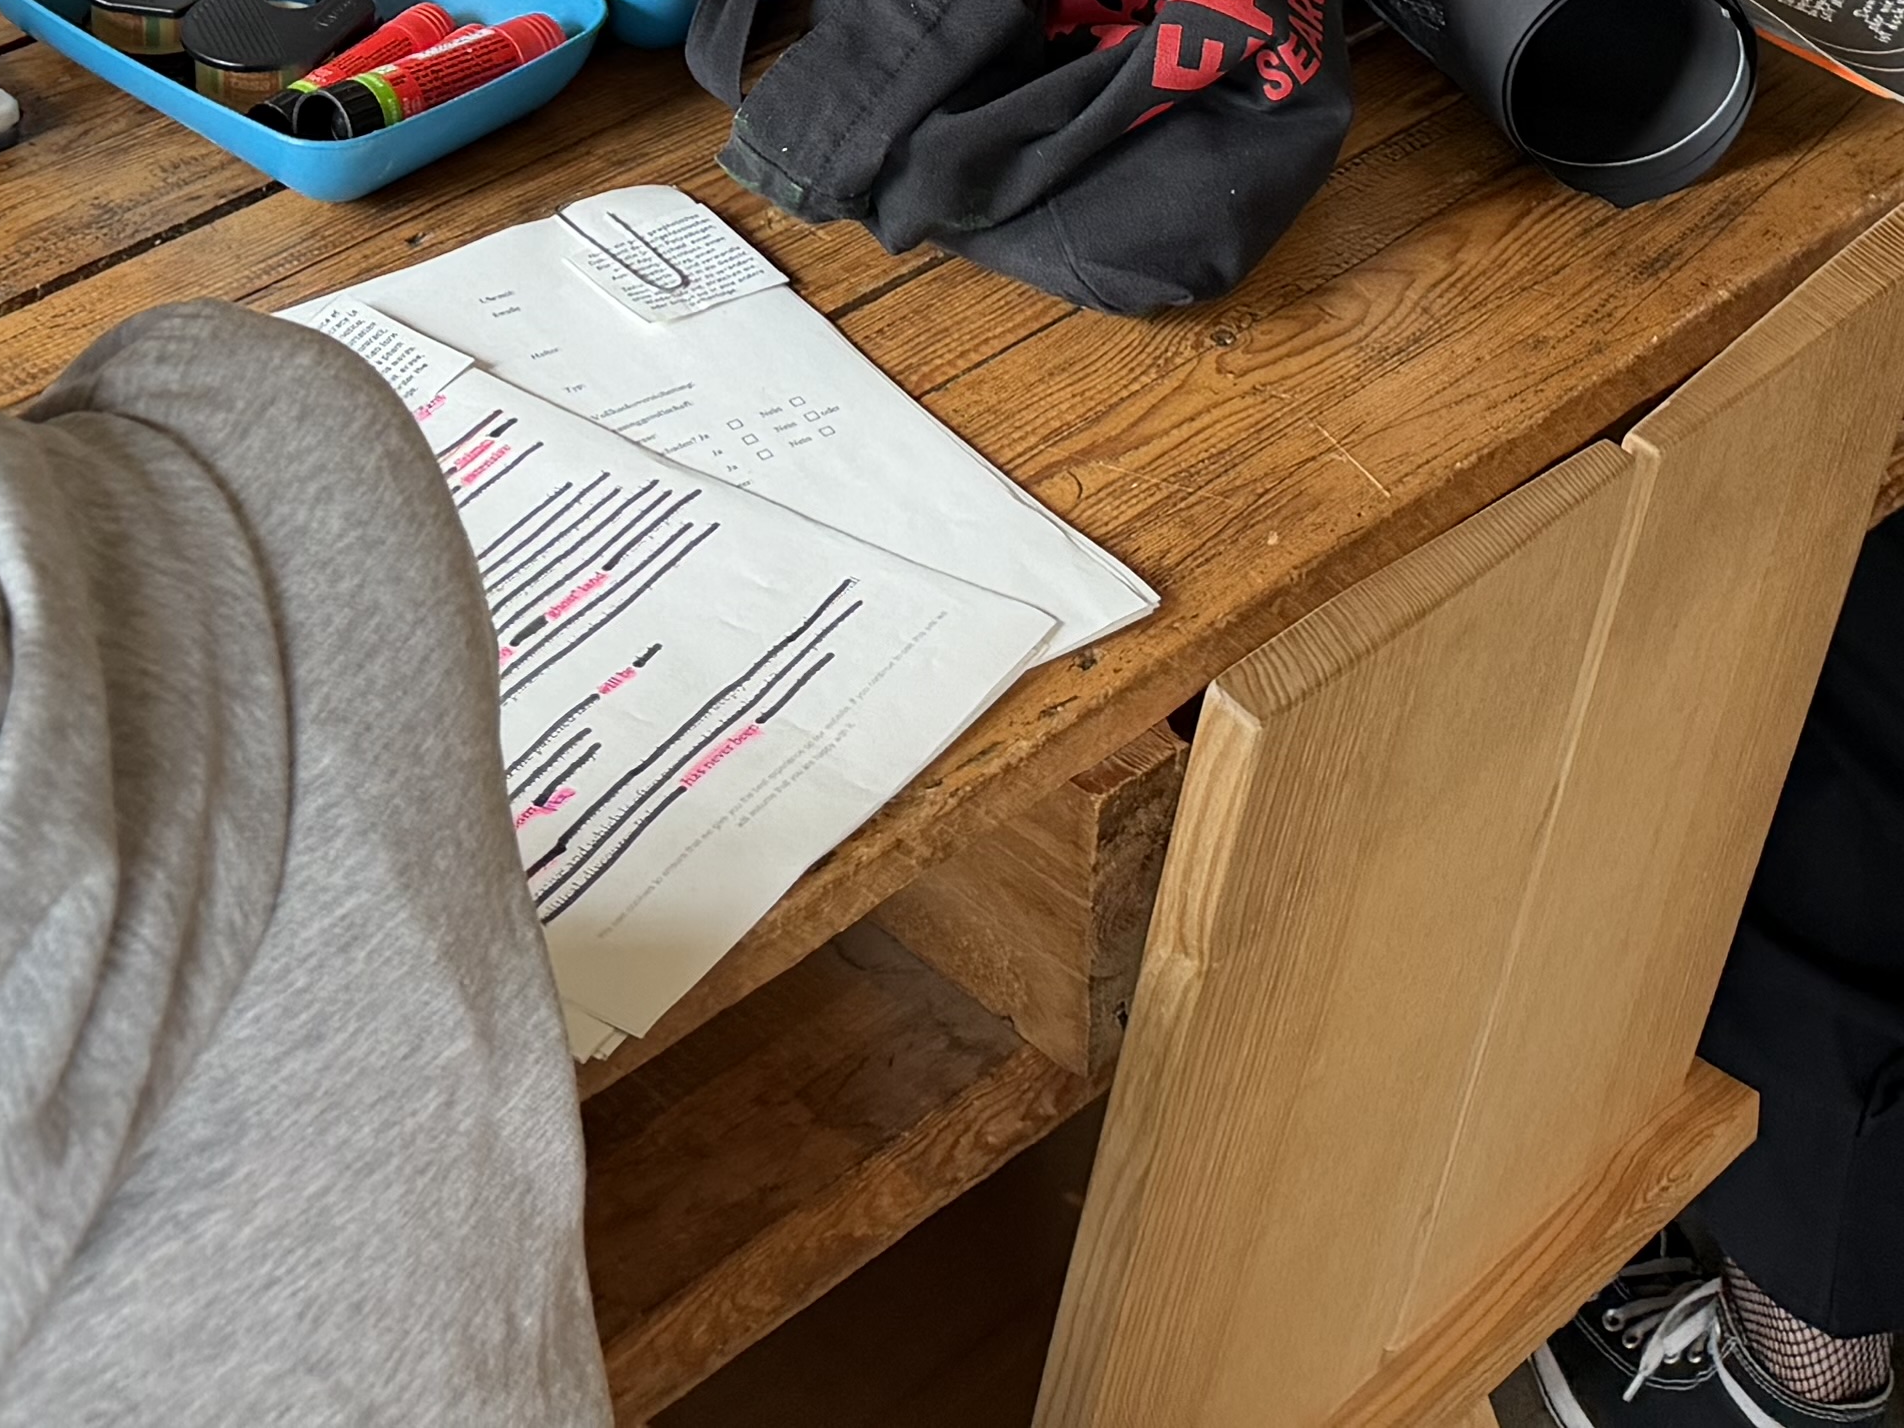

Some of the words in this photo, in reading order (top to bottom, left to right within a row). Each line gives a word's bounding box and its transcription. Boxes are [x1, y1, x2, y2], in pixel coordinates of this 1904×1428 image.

[680, 763, 707, 790] has
[701, 740, 735, 772] never
[728, 719, 761, 750] been
